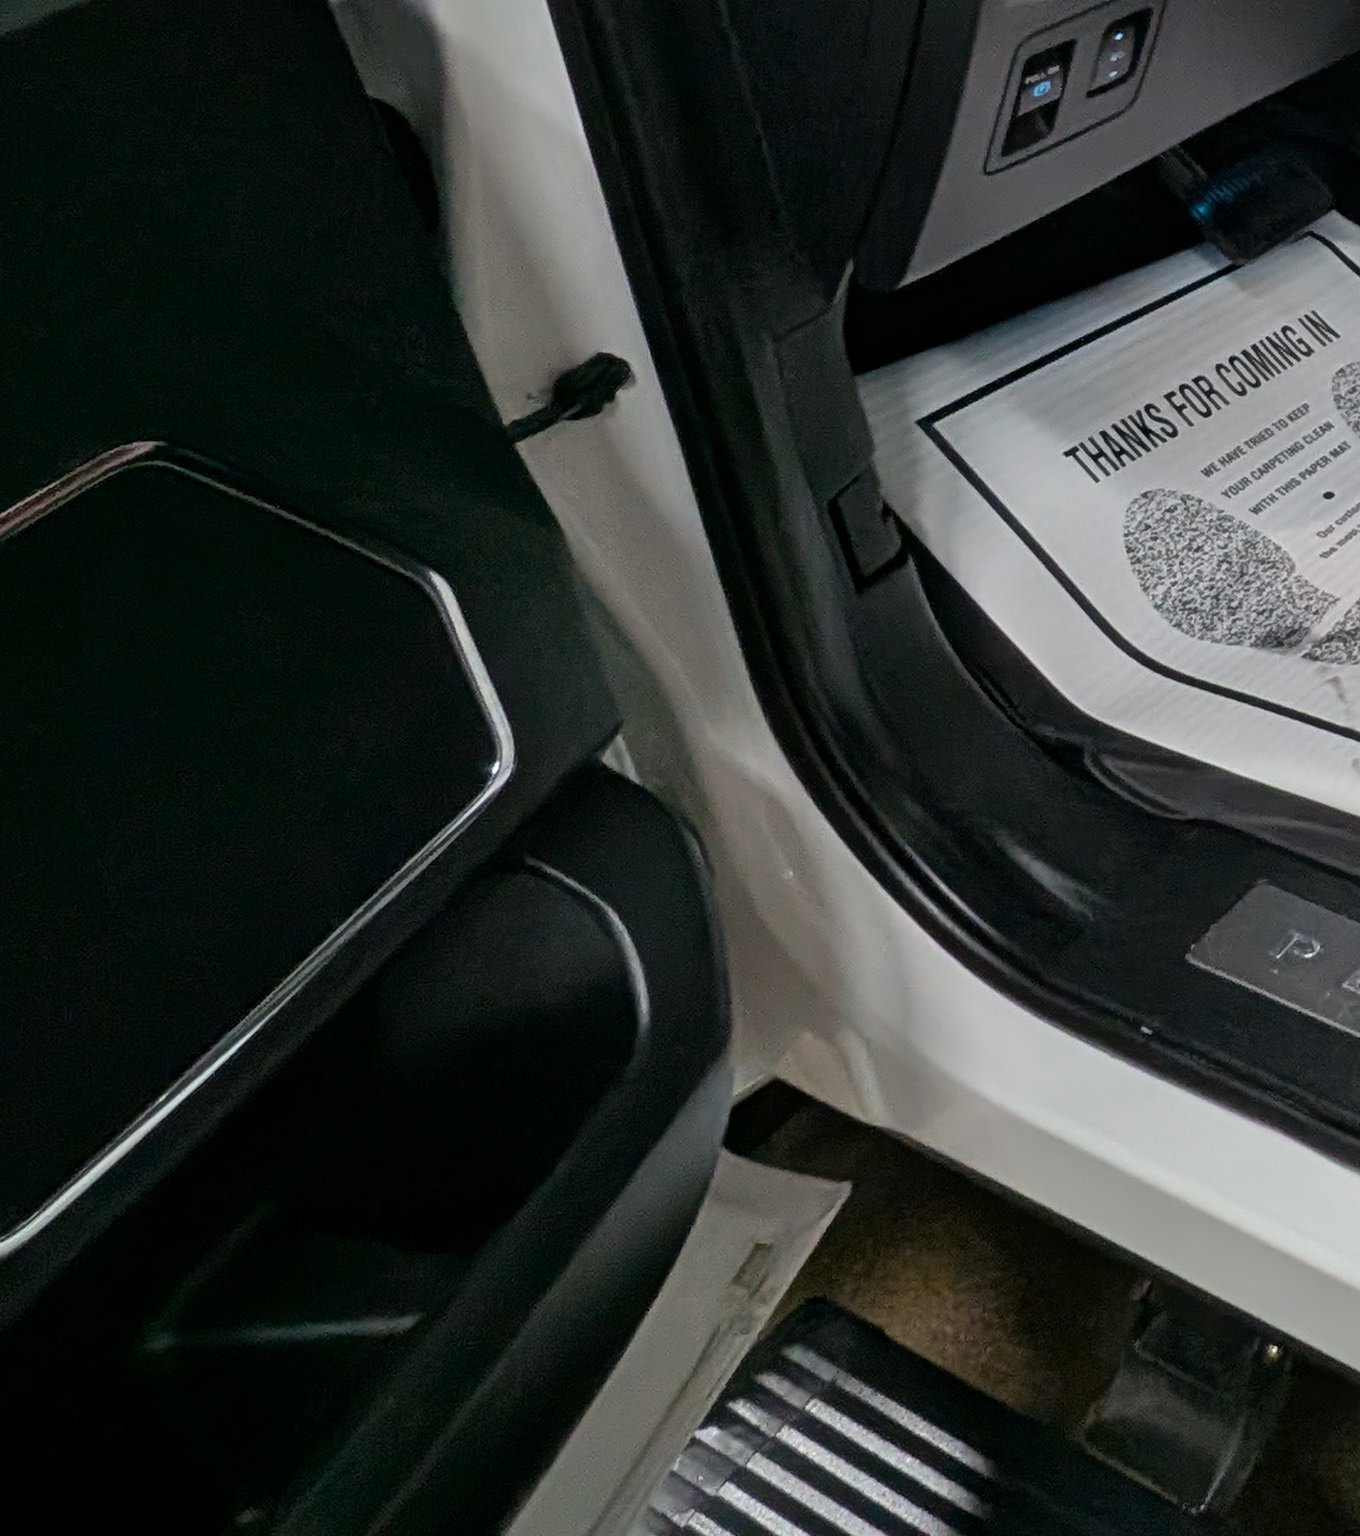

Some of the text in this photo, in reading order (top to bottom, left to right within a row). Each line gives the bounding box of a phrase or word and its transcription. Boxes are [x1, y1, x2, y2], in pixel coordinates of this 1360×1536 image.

[1063, 310, 1340, 483] THANKS FOR COMING IN
[1200, 402, 1310, 478] WE HAVE TRIED TO KEEP
[1220, 421, 1335, 499] YOUR CARPETING CLEAN
[1248, 440, 1352, 515] WITH THIS PAPER MAT
[1316, 524, 1335, 538] Our
[1319, 547, 1338, 559] the
[1336, 529, 1360, 546] most
